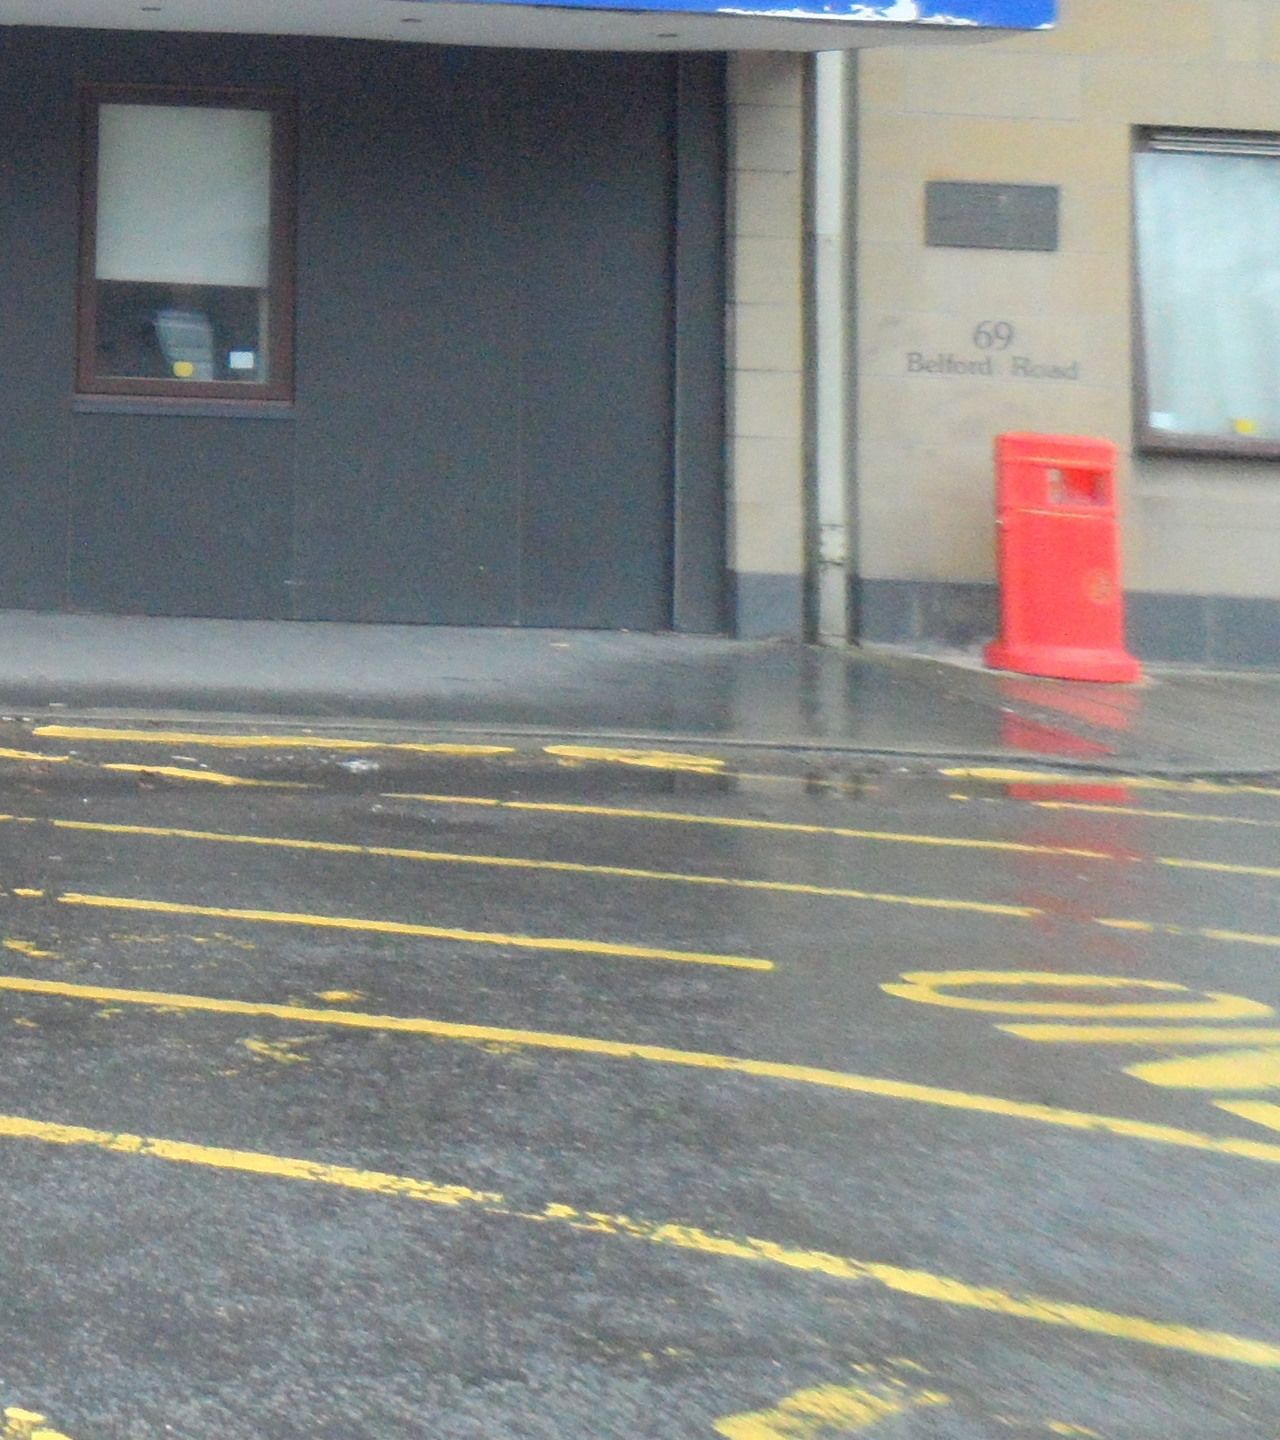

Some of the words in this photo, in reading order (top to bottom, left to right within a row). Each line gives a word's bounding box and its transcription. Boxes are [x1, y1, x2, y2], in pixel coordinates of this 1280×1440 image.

[972, 320, 1014, 351] 69
[906, 352, 993, 375] Belford
[1011, 356, 1079, 380] Road
